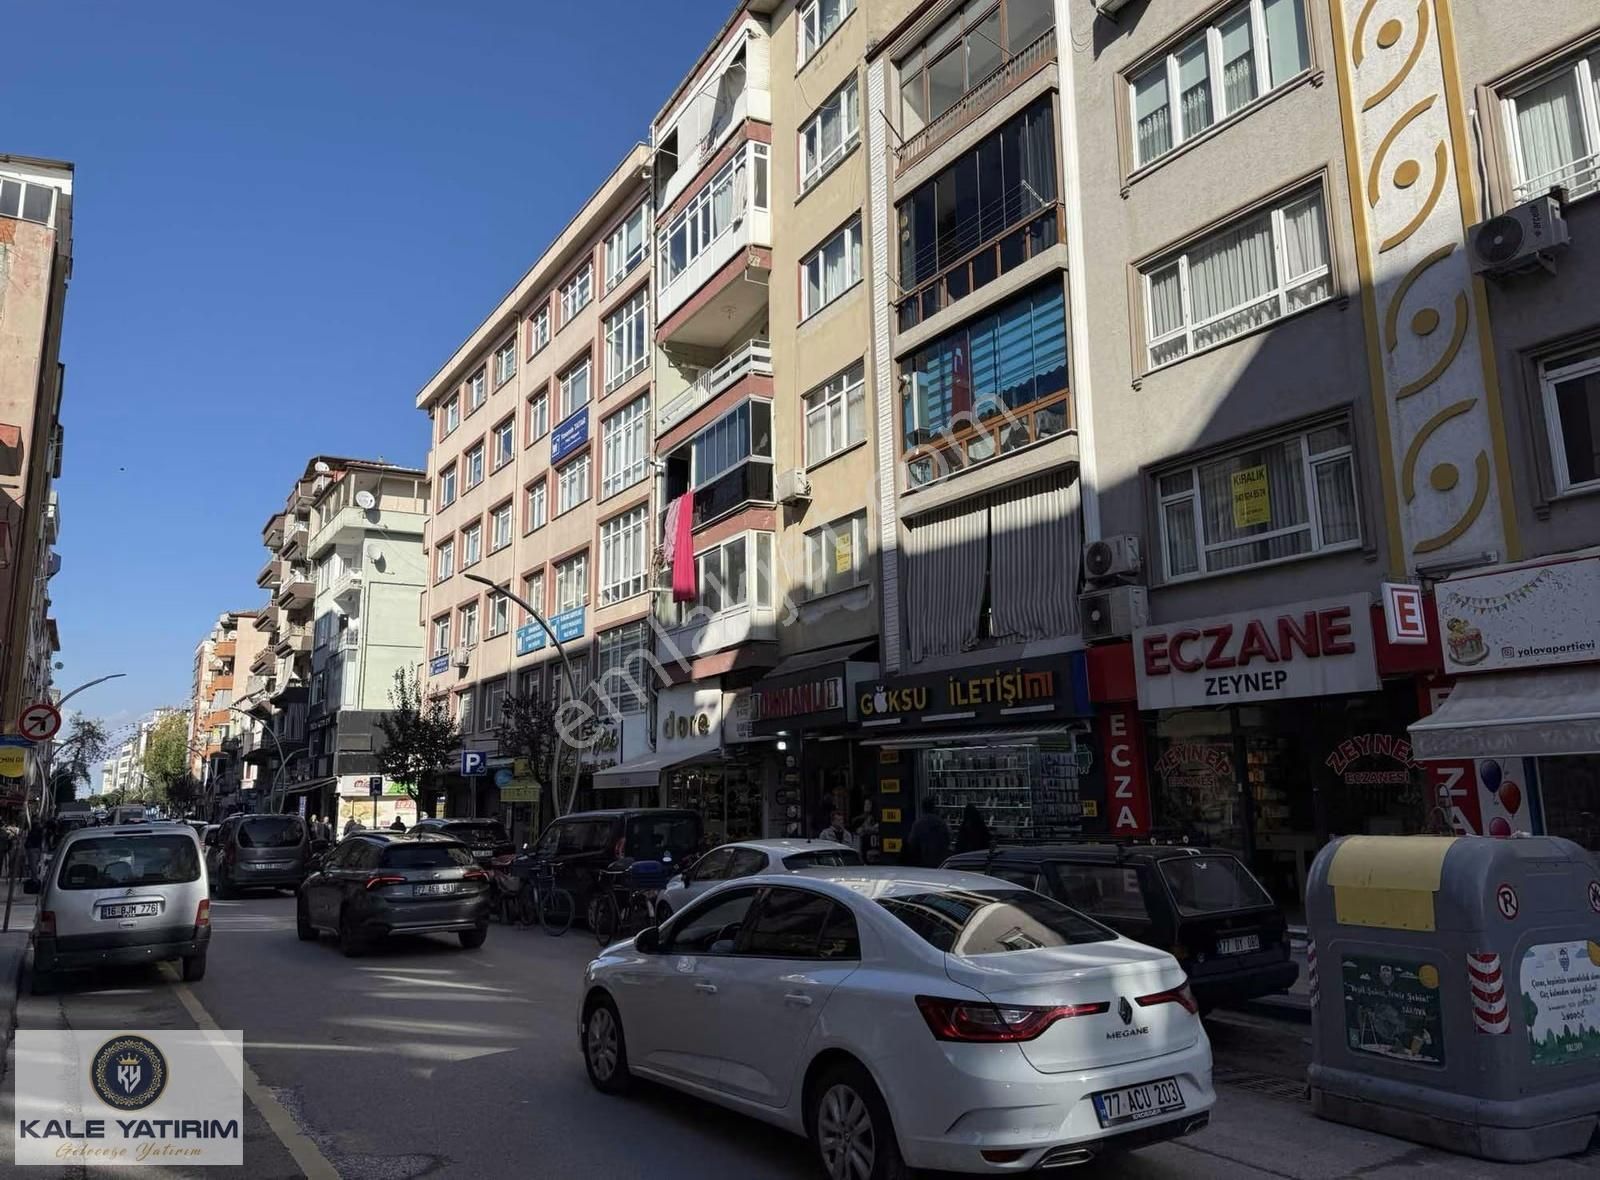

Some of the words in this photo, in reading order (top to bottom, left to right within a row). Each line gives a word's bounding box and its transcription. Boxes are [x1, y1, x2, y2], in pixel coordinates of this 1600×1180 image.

[1397, 595, 1419, 630] E
[1143, 606, 1355, 676] ECZANE
[1517, 639, 1596, 658] yalovapartievi
[1205, 670, 1288, 697] ZEYNEP
[663, 711, 710, 740] dore
[466, 753, 481, 773] P
[141, 904, 156, 913] 776
[1106, 1026, 1149, 1039] MEGANE
[1104, 1093, 1120, 1117] 77
[1128, 1087, 1151, 1112] ACU
[1154, 1082, 1178, 1105] 203
